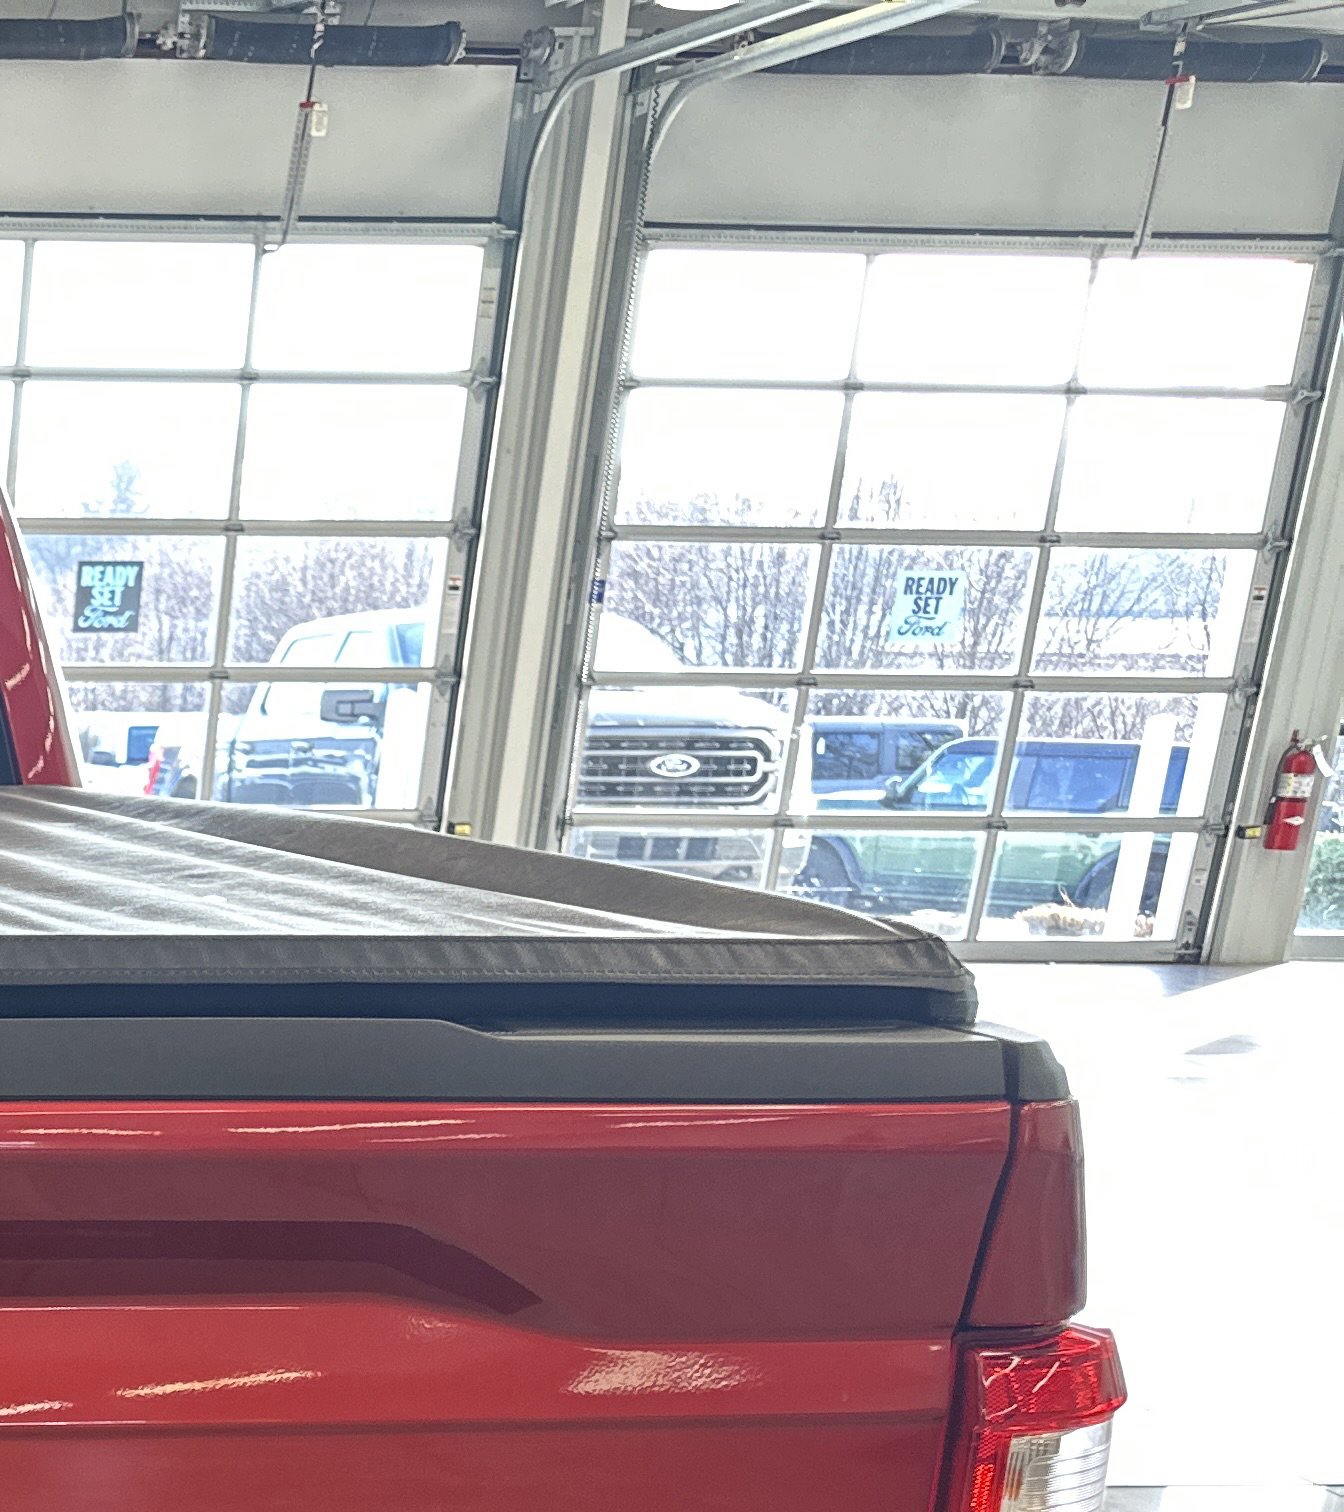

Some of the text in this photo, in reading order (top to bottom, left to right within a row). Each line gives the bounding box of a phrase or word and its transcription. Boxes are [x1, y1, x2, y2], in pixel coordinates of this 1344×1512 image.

[80, 565, 140, 587] READY
[903, 577, 958, 595] READY
[90, 586, 125, 606] SET
[912, 597, 943, 614] SET
[77, 605, 135, 628] Ford
[897, 615, 949, 636] Ford
